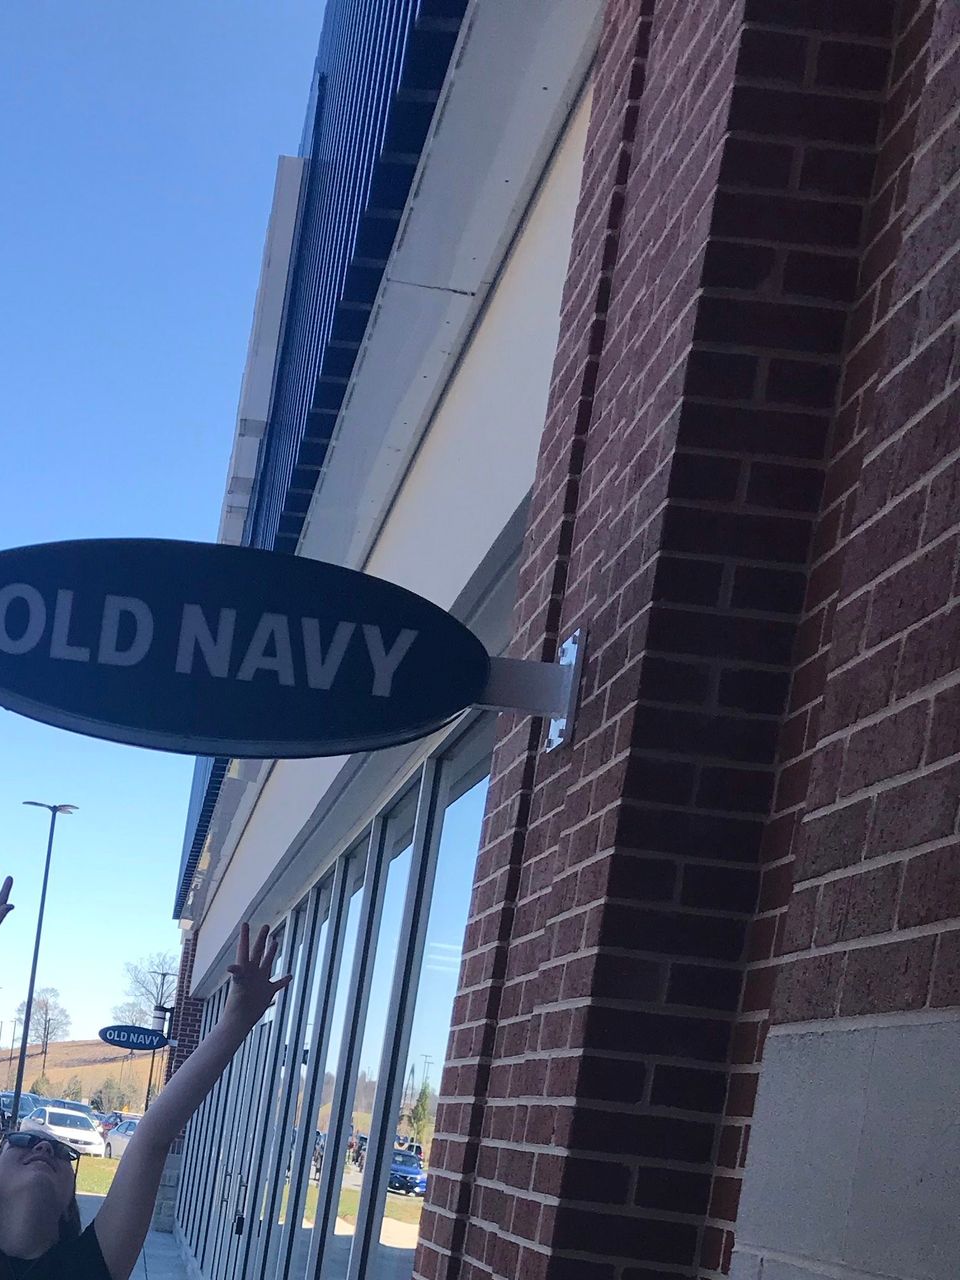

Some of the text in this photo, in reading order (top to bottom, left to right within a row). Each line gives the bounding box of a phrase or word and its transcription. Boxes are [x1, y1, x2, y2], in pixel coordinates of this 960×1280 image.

[175, 603, 419, 698] NAVY
[106, 1030, 159, 1046] OLD NAVY
